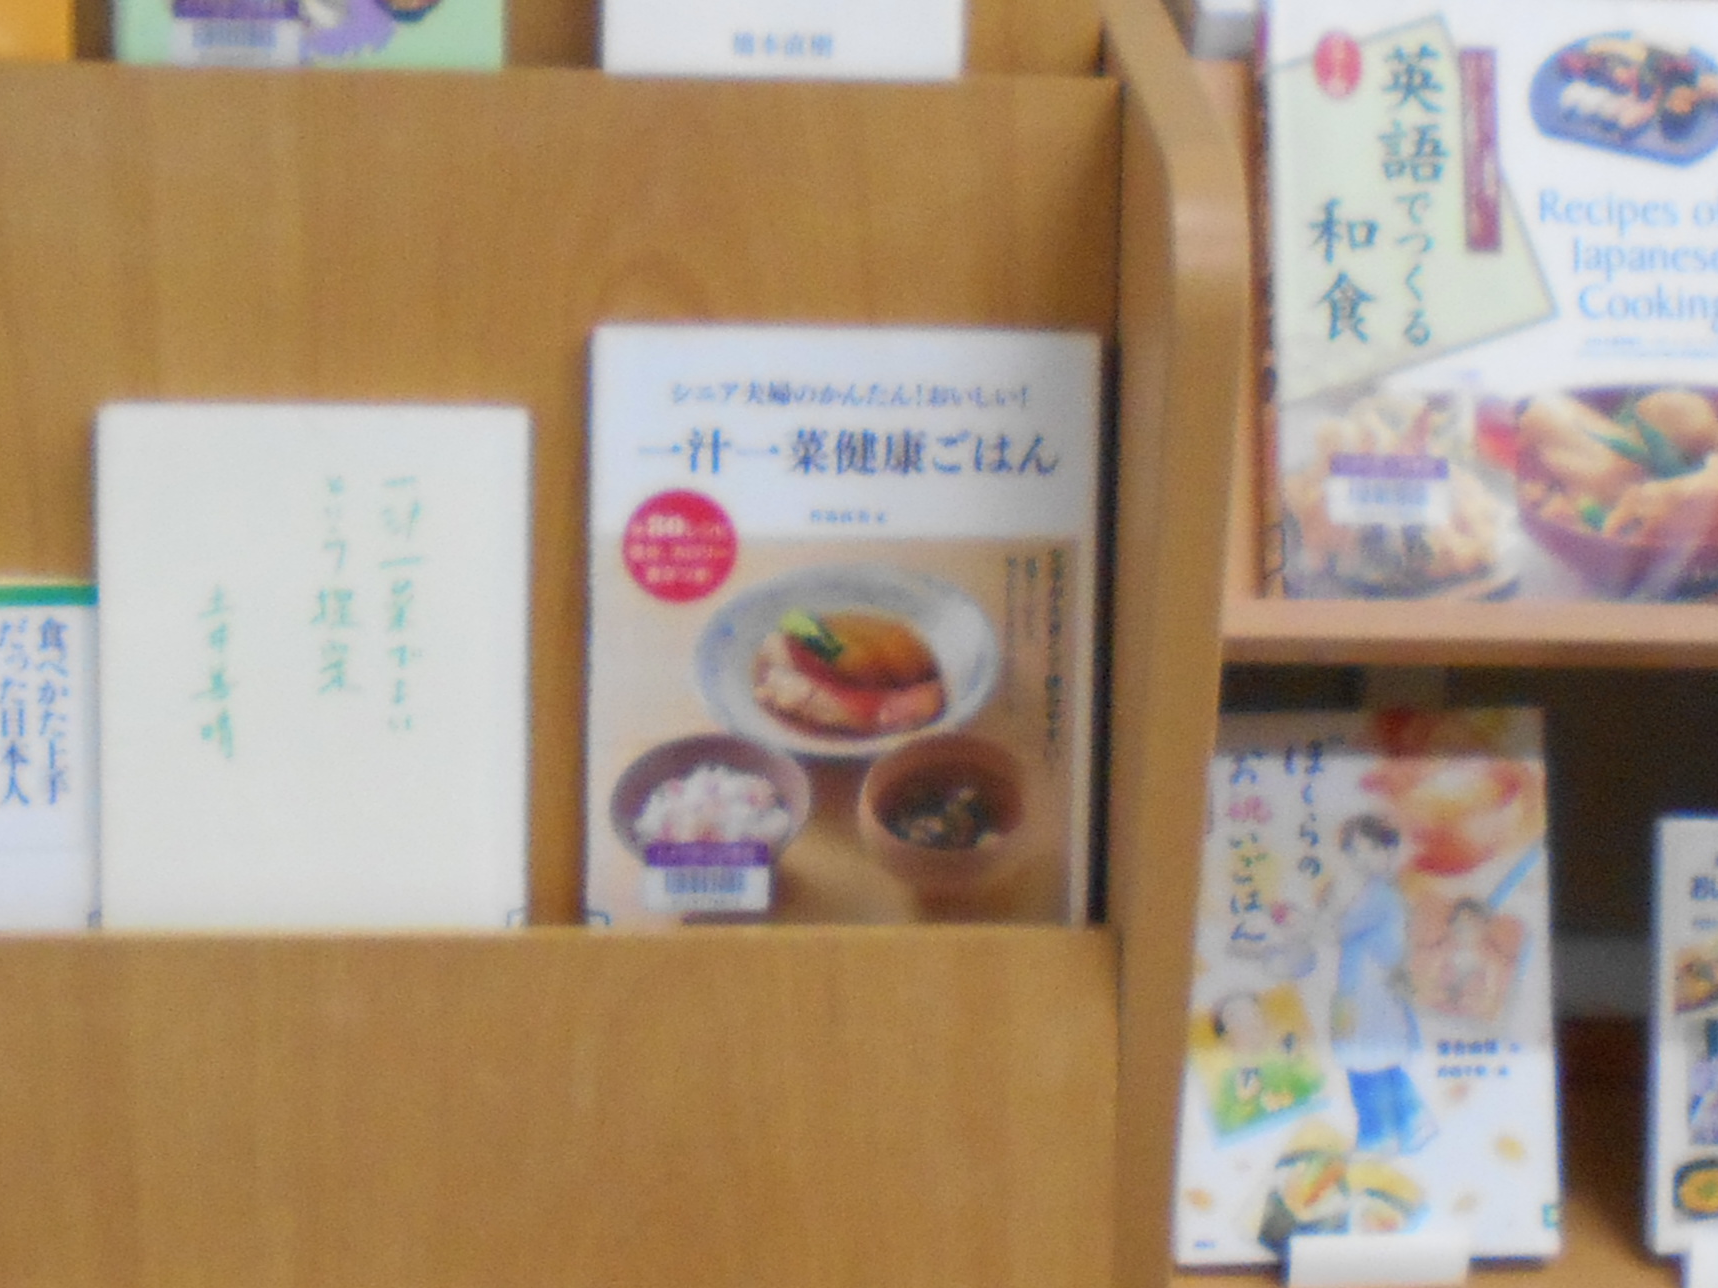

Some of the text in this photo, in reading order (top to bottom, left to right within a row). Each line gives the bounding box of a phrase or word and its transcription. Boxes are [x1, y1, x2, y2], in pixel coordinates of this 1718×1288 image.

[1381, 41, 1450, 348] 英語でつくる
[1536, 188, 1681, 235] Recipes
[1309, 195, 1380, 345] 和食
[637, 426, 1060, 477] 一汁一菜健康ごはん
[37, 615, 71, 806] 食べかた上手
